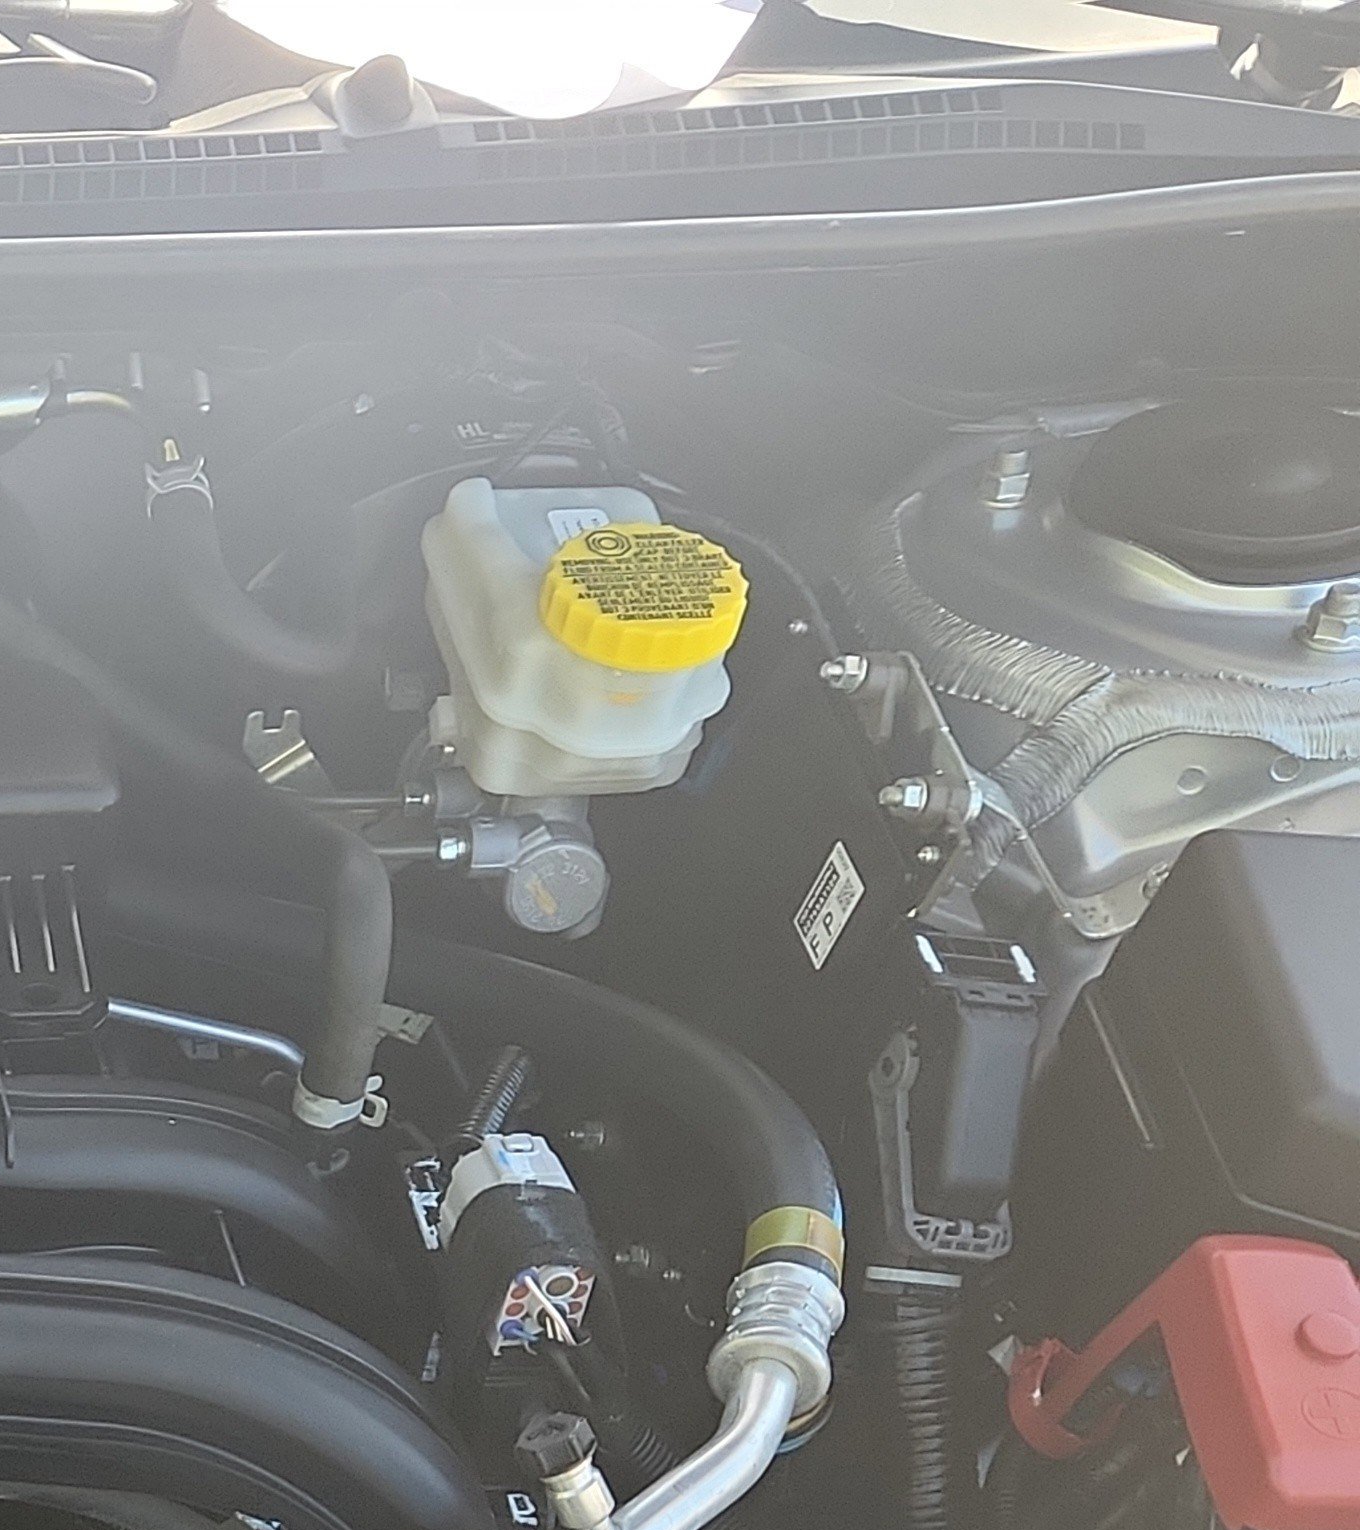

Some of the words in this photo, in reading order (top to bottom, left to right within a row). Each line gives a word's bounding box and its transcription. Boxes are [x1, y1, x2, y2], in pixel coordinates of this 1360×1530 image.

[594, 564, 622, 573] FROM
[578, 590, 611, 599] AVANT
[597, 596, 656, 605] SEULEMENT
[617, 612, 674, 621] CONTENANT
